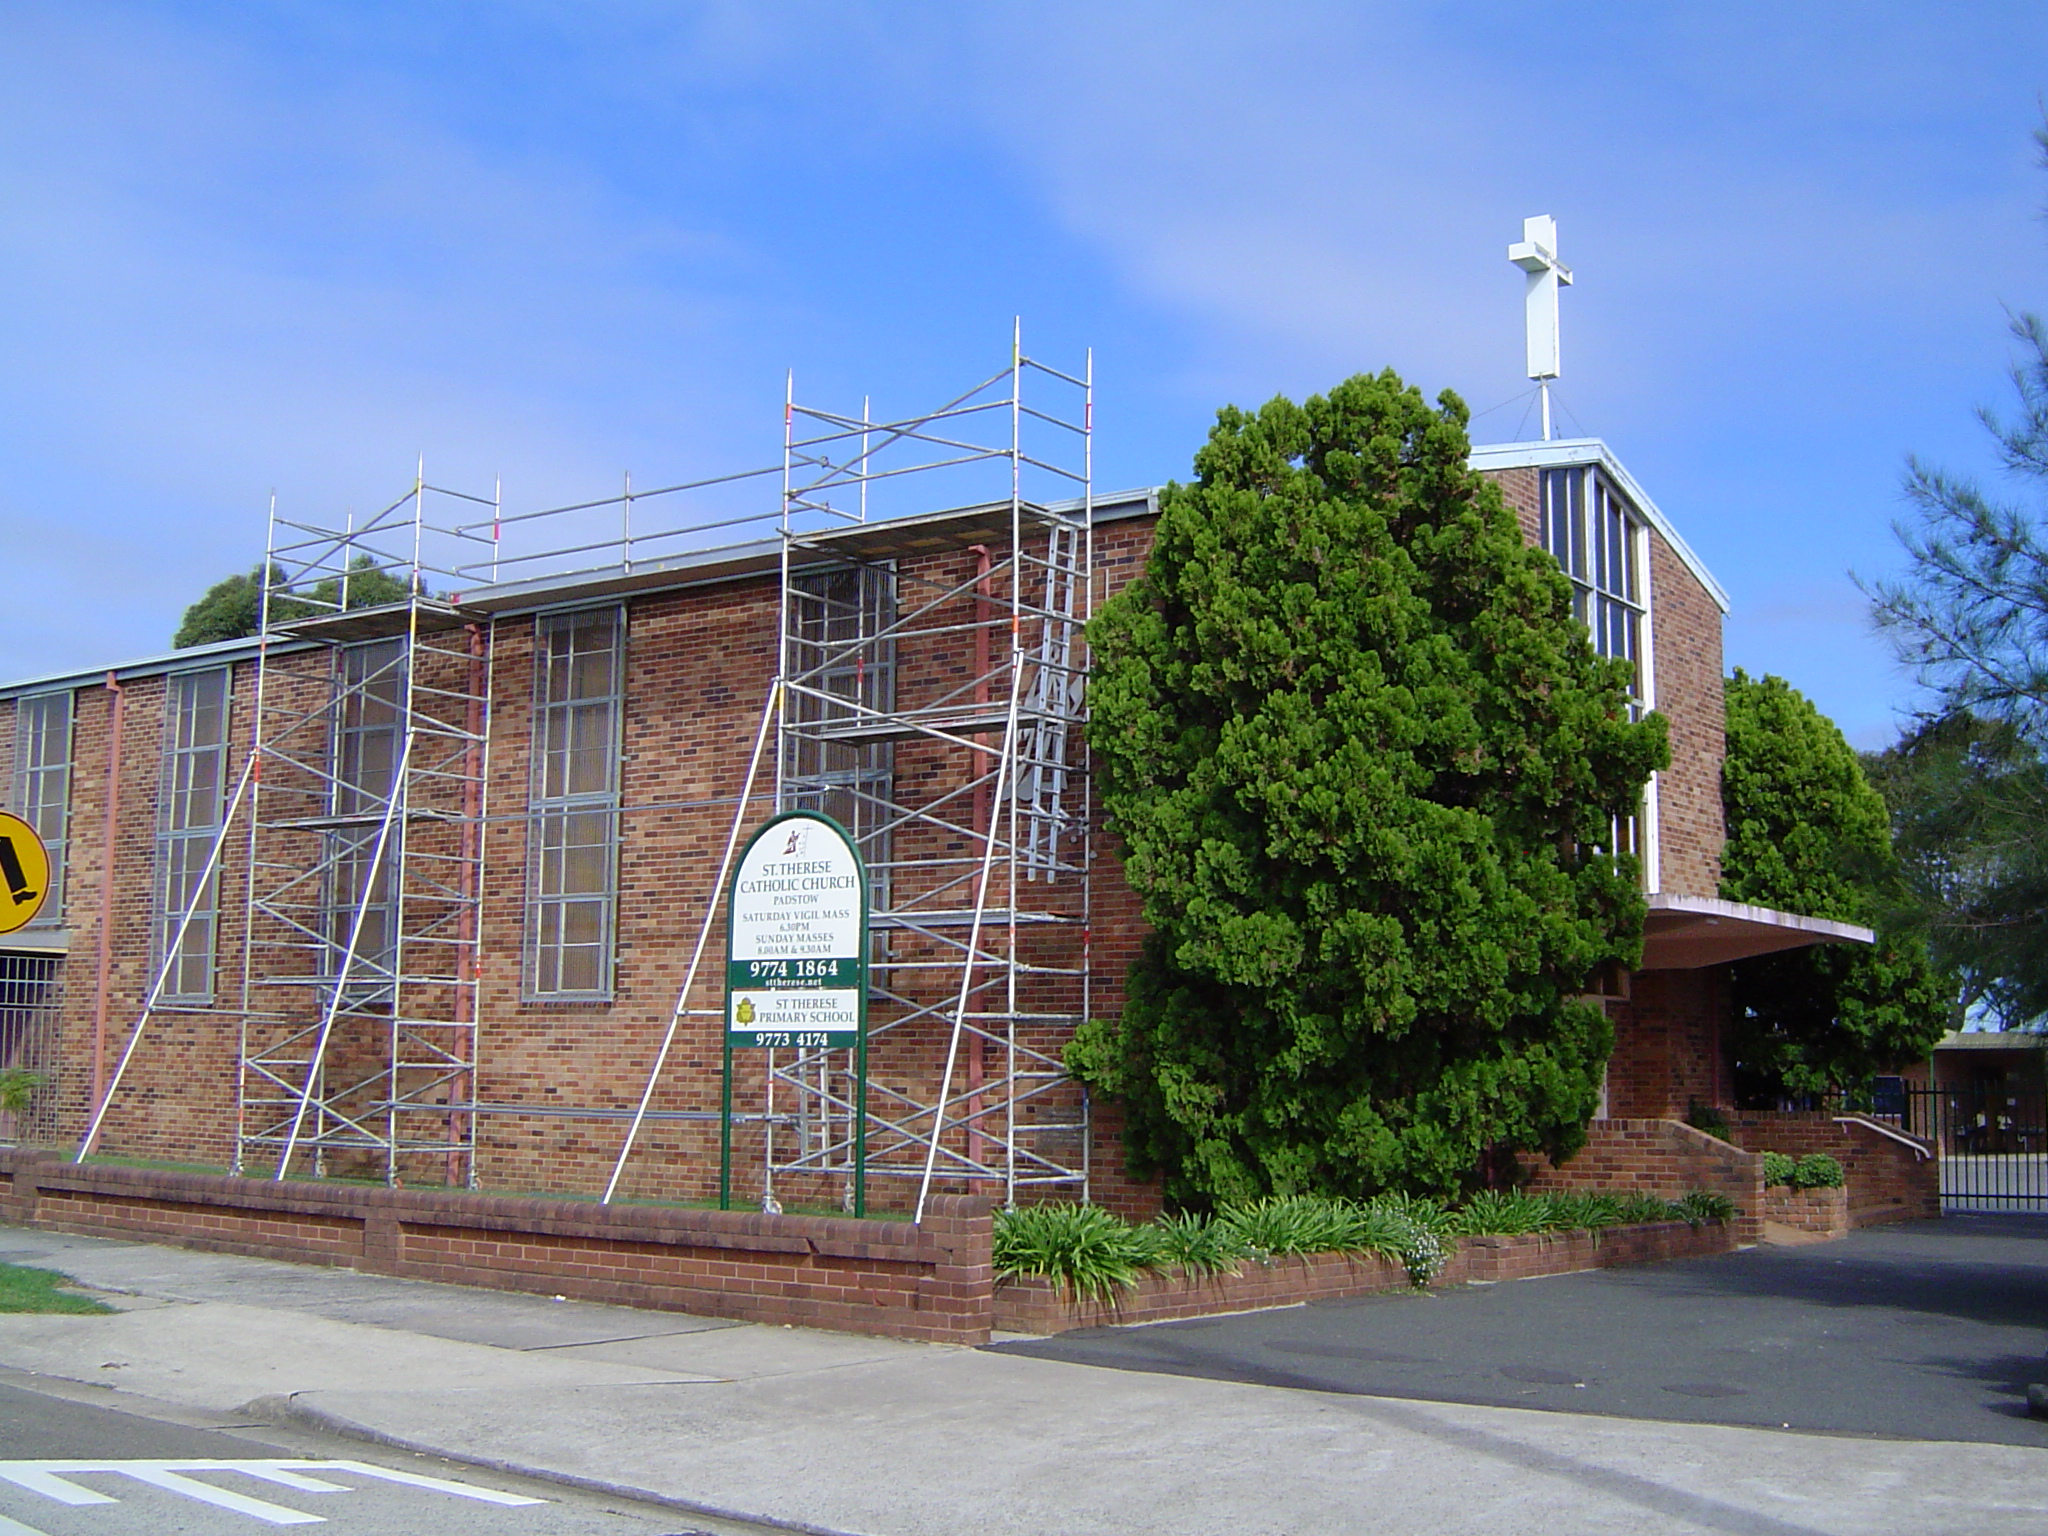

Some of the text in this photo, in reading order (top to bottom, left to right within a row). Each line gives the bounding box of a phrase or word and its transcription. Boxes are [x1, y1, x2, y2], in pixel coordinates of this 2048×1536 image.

[779, 860, 832, 875] THERESE
[740, 876, 855, 893] CATHOLIC CHURCH
[773, 894, 819, 906] PADSTOW
[742, 909, 850, 922] SATURDAY VIGIL MASS
[755, 932, 834, 944] SUNDAY MASSES
[750, 960, 838, 978] 9774 1864
[776, 998, 838, 1009] ST THERESE
[759, 1011, 855, 1023] PRIMARY SCHOOL
[756, 1032, 828, 1047] 9773 4174
